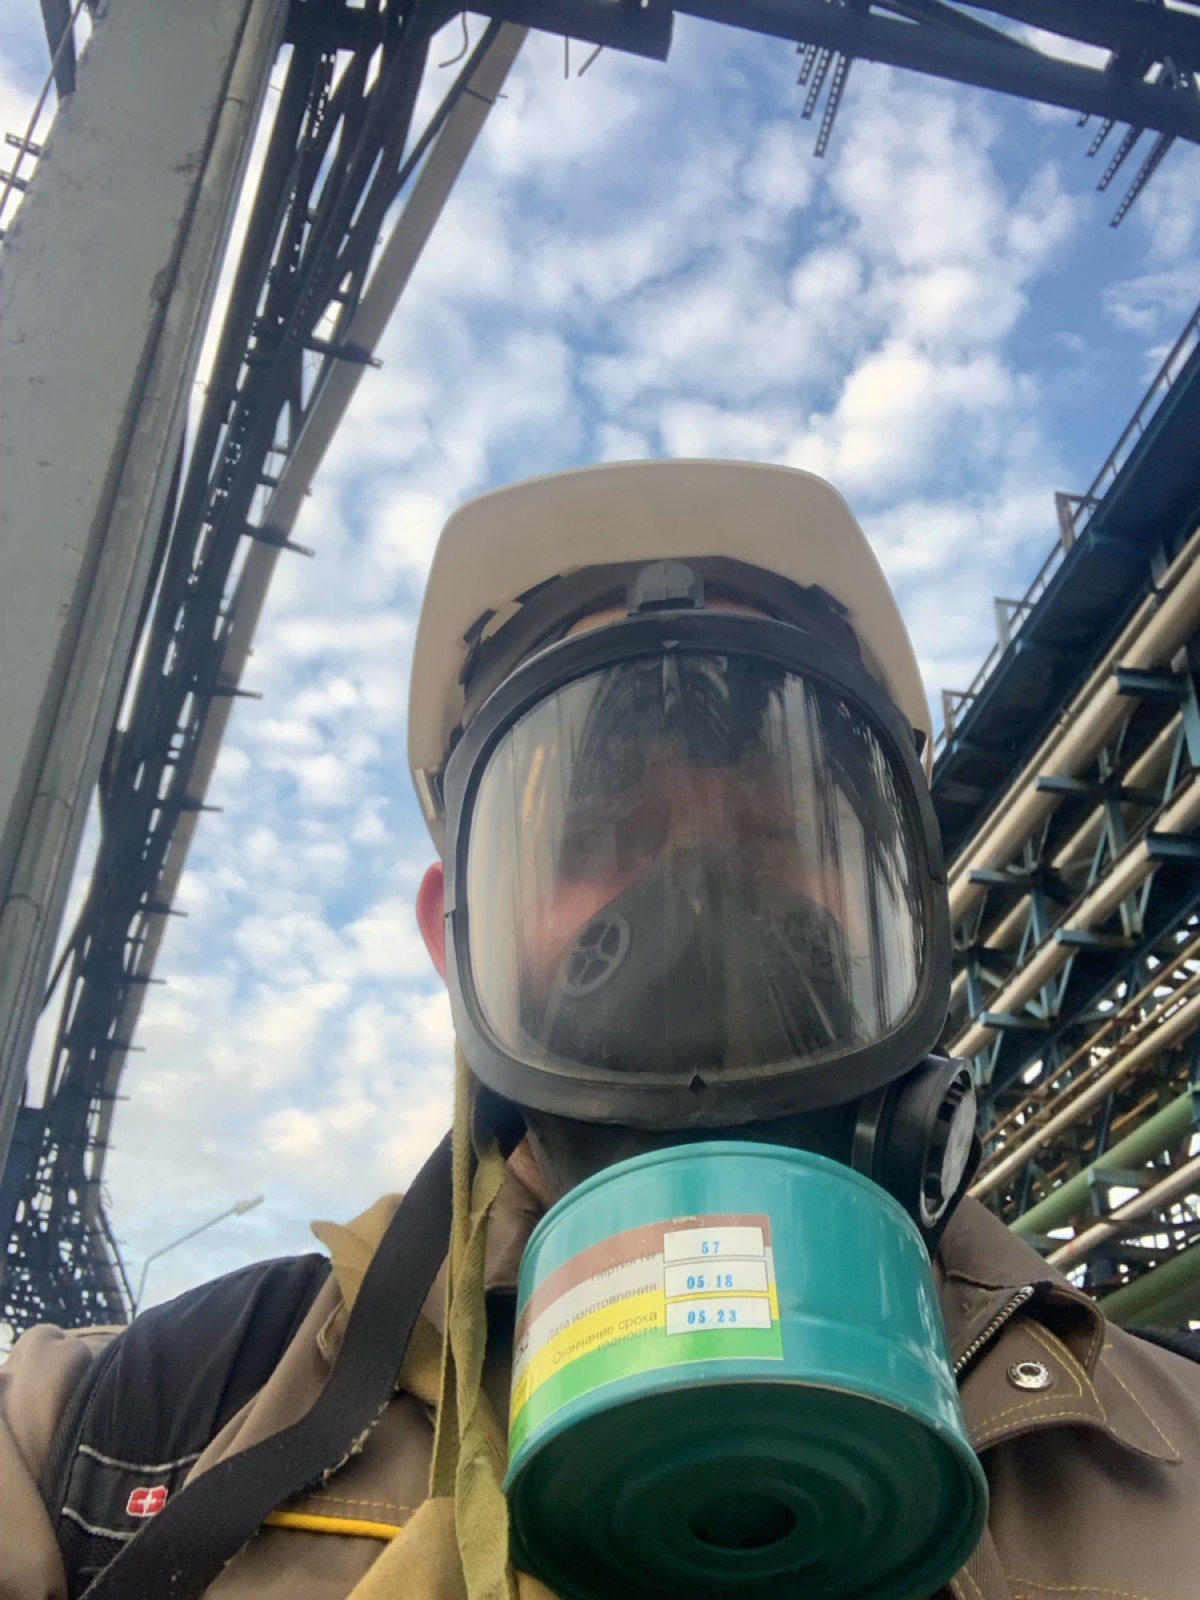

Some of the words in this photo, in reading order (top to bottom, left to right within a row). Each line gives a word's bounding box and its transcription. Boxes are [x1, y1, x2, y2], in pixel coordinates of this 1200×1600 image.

[701, 1240, 720, 1254] 57
[547, 1319, 570, 1345] Дата
[572, 1282, 657, 1324] изготовления
[552, 1325, 614, 1365] Окончание
[618, 1311, 658, 1332] срока
[597, 1324, 658, 1352] годности
